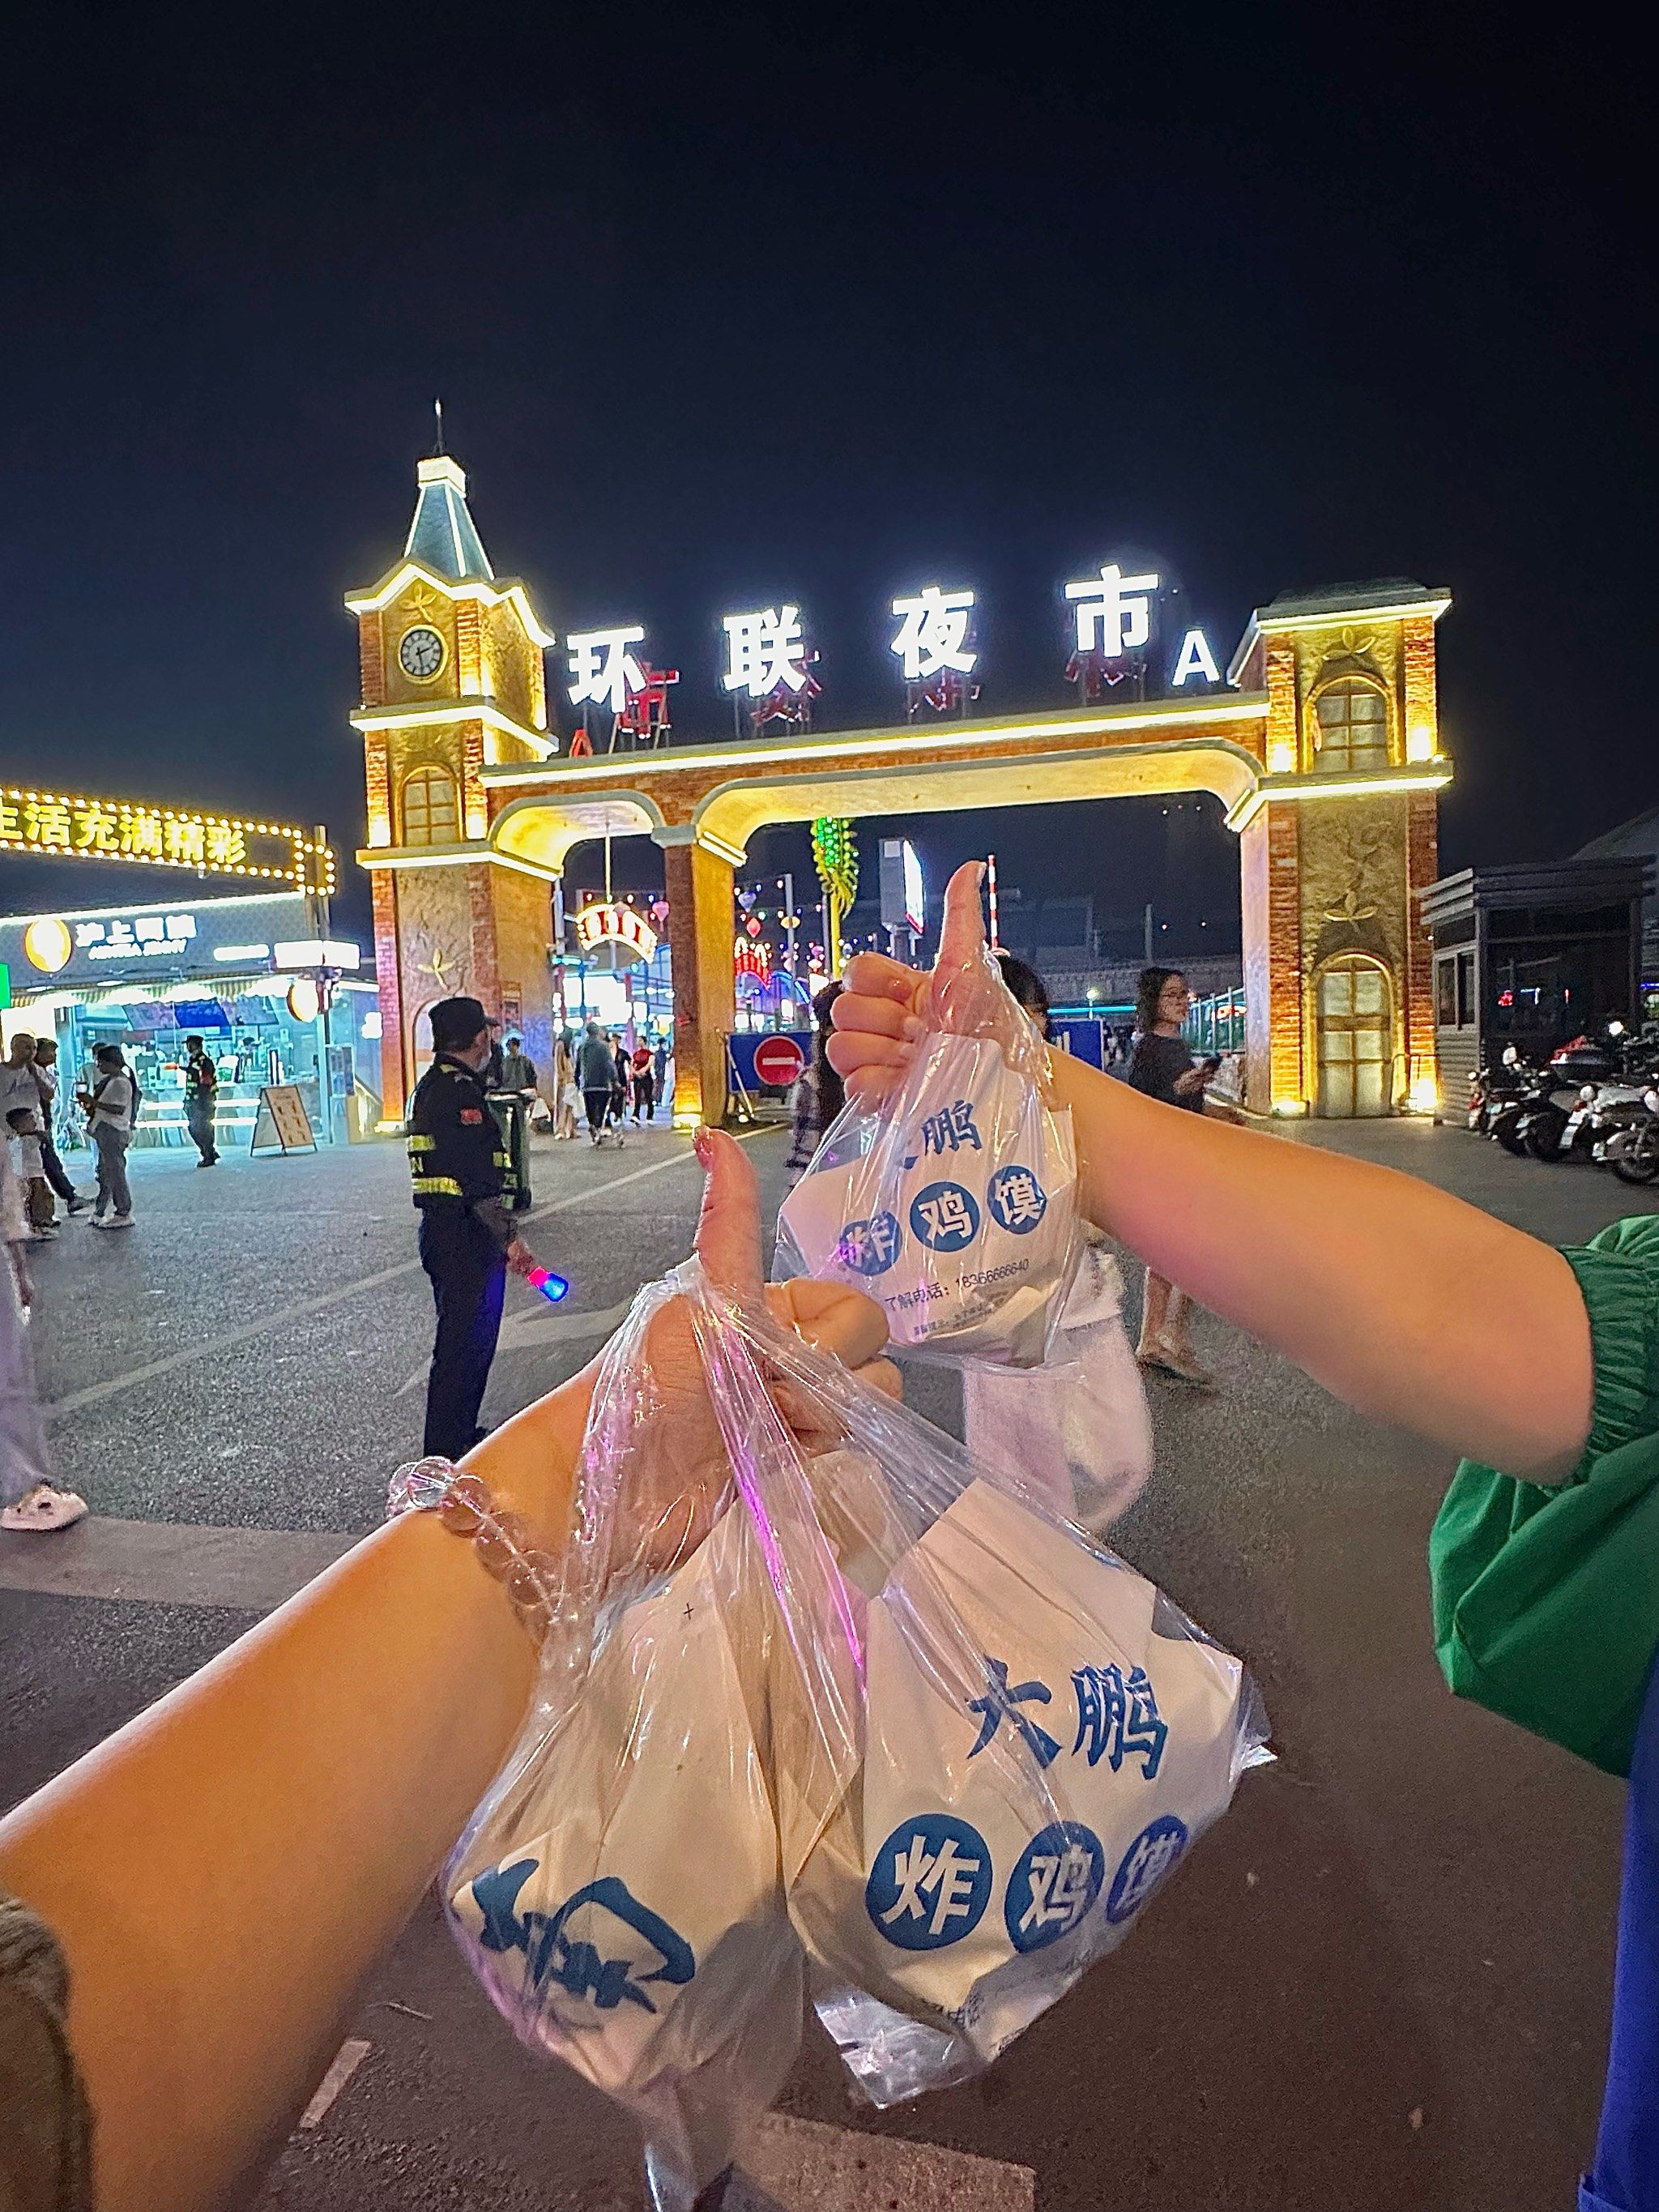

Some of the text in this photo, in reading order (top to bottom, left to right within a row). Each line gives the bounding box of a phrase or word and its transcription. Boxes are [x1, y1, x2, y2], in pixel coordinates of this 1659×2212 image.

[566, 564, 1159, 714] 环联夜市
[1172, 629, 1220, 686] A
[899, 1100, 983, 1169] 鹏
[966, 1654, 1169, 1781] 大鹏
